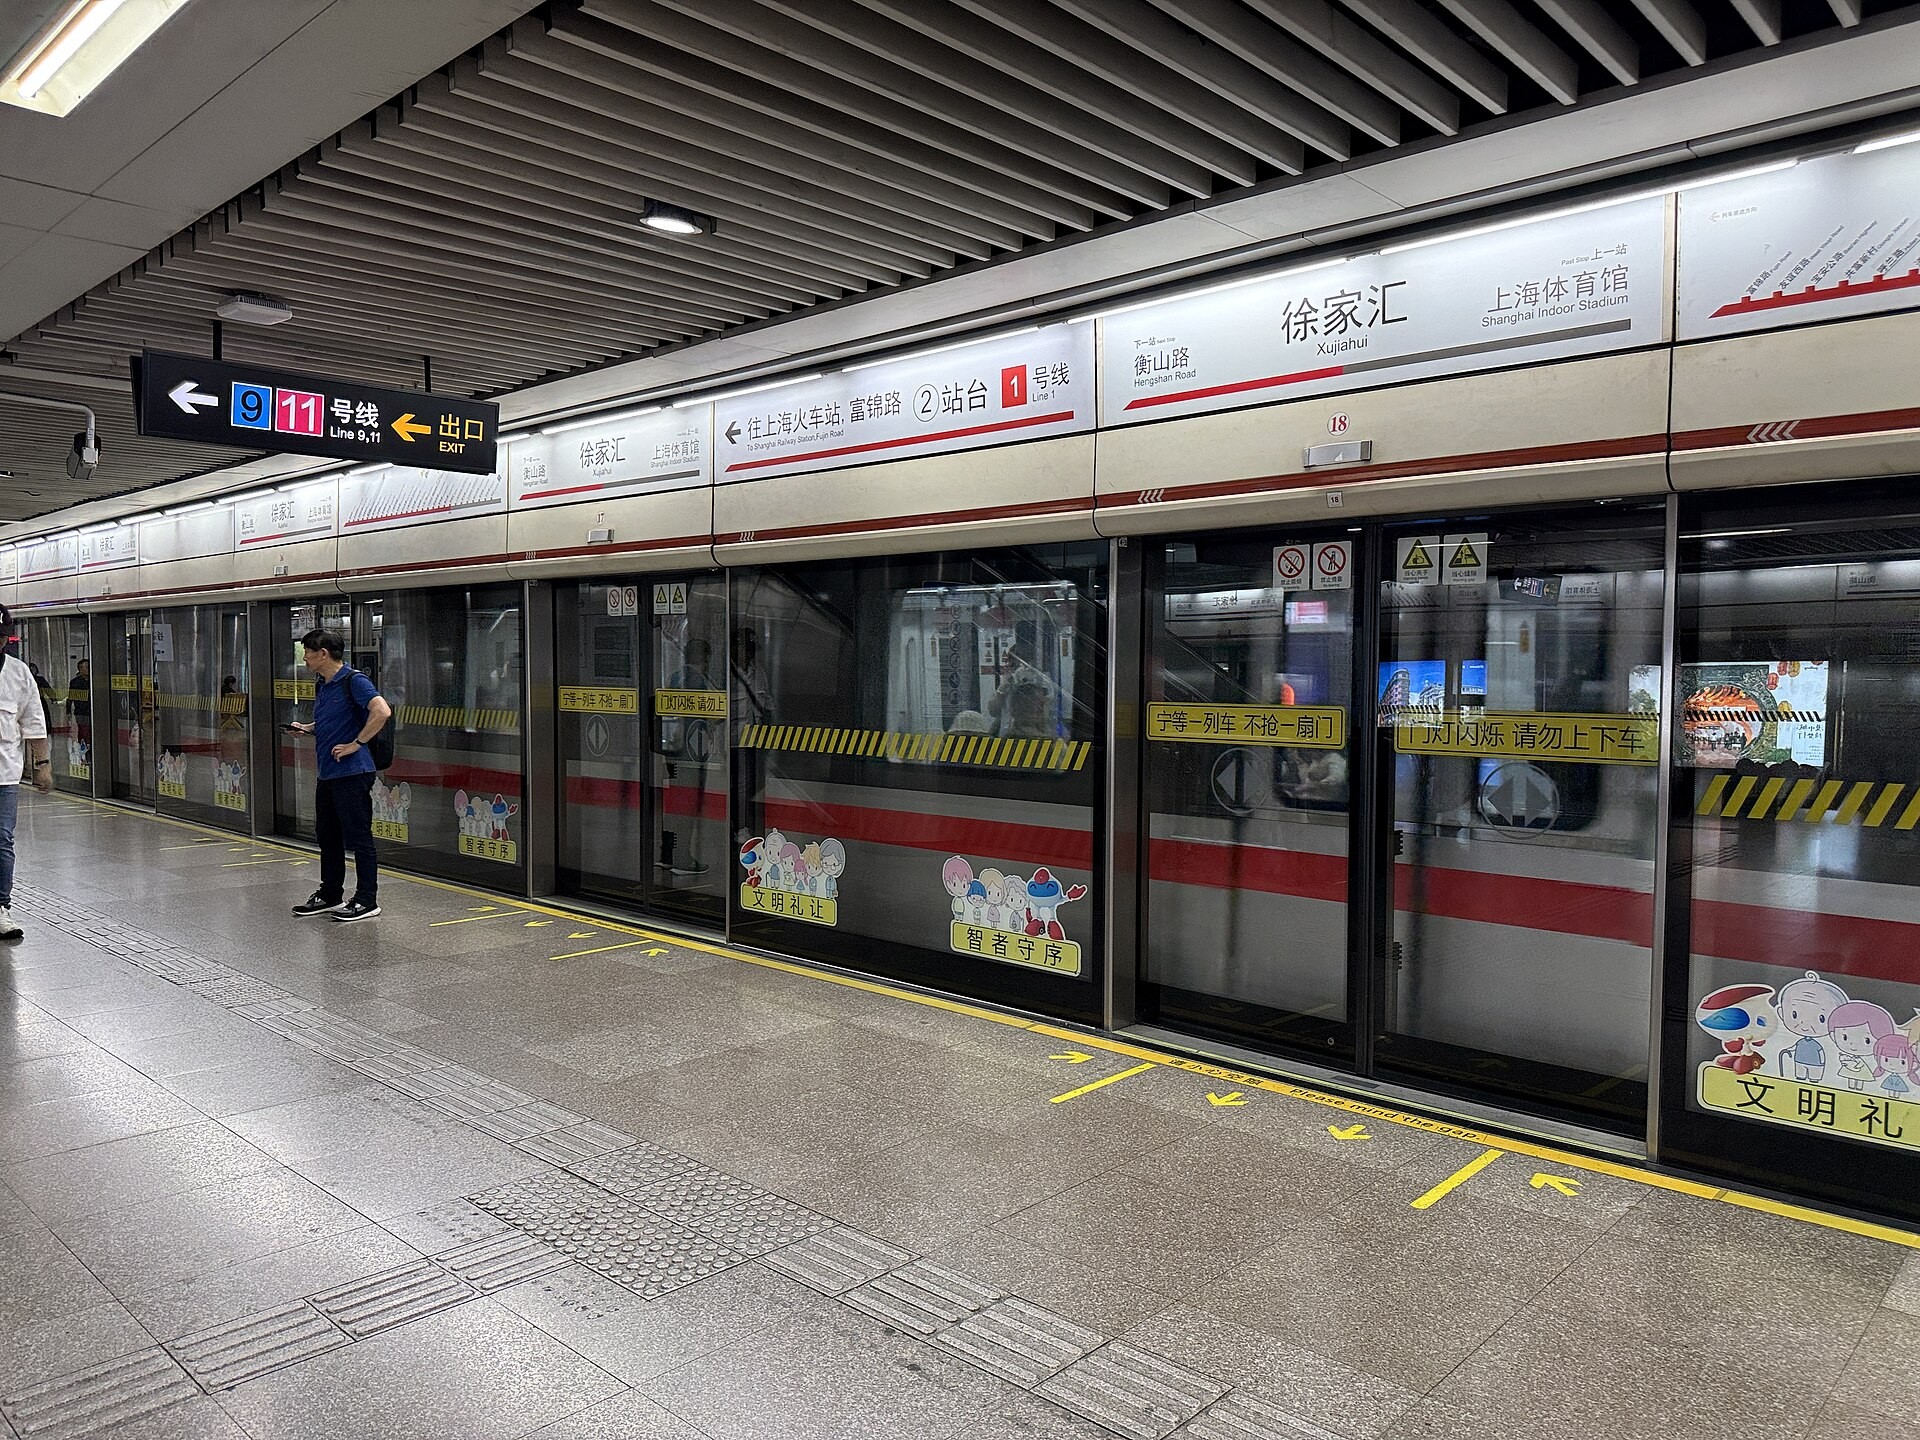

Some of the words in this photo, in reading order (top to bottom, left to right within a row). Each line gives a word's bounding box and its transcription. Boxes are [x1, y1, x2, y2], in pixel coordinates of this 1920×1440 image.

[1576, 256, 1589, 264] Stop
[1591, 243, 1628, 261] 上一站
[1487, 264, 1629, 313] 上海体育馆
[1281, 281, 1408, 345] 徐家汇
[1482, 309, 1534, 327] Shanghai
[1538, 303, 1575, 318] Indoor
[1579, 295, 1629, 311] Stadium
[1134, 336, 1156, 349] 下一站
[1316, 334, 1369, 358] Xujiahui
[1134, 346, 1189, 377] 衡山路
[1032, 363, 1070, 390] 号线
[1134, 374, 1173, 387] Hengshan
[1175, 369, 1196, 381] Road
[241, 390, 263, 422] 9
[850, 390, 901, 423] 富锦路
[942, 379, 988, 415] 站台
[1032, 392, 1048, 402] Line
[1052, 389, 1056, 399] 1
[280, 396, 314, 431] 11
[330, 398, 380, 429] 号线
[439, 413, 484, 442] 出口
[1330, 415, 1348, 432] 18
[330, 426, 354, 440] Line
[357, 430, 381, 444] 9,11
[439, 441, 465, 454] EXIT
[653, 439, 700, 460] 上海体育馆
[747, 444, 753, 452] To
[754, 441, 776, 450] Shanghai
[777, 437, 796, 447] Railway
[830, 429, 844, 437] Road
[579, 437, 626, 468] 徐家汇
[563, 693, 596, 708] 宁等一列车
[598, 693, 634, 709] 不抢一扇门
[660, 694, 696, 711] 门灯闪烁
[697, 695, 727, 712] 请勿上
[1156, 710, 1237, 735] 宁等一列车
[1244, 714, 1332, 740] 不抢一扇门
[1408, 720, 1505, 747] 门灯闪烁
[1512, 722, 1644, 754] 请勿上下车
[466, 837, 509, 859] 智者守序
[752, 890, 825, 920] 文明礼让
[966, 927, 1064, 966] 智者守序
[1735, 1077, 1904, 1138] 文明礼
[1350, 1103, 1400, 1119] mind
[1402, 1114, 1434, 1129] the
[1437, 1125, 1481, 1142] gap.
